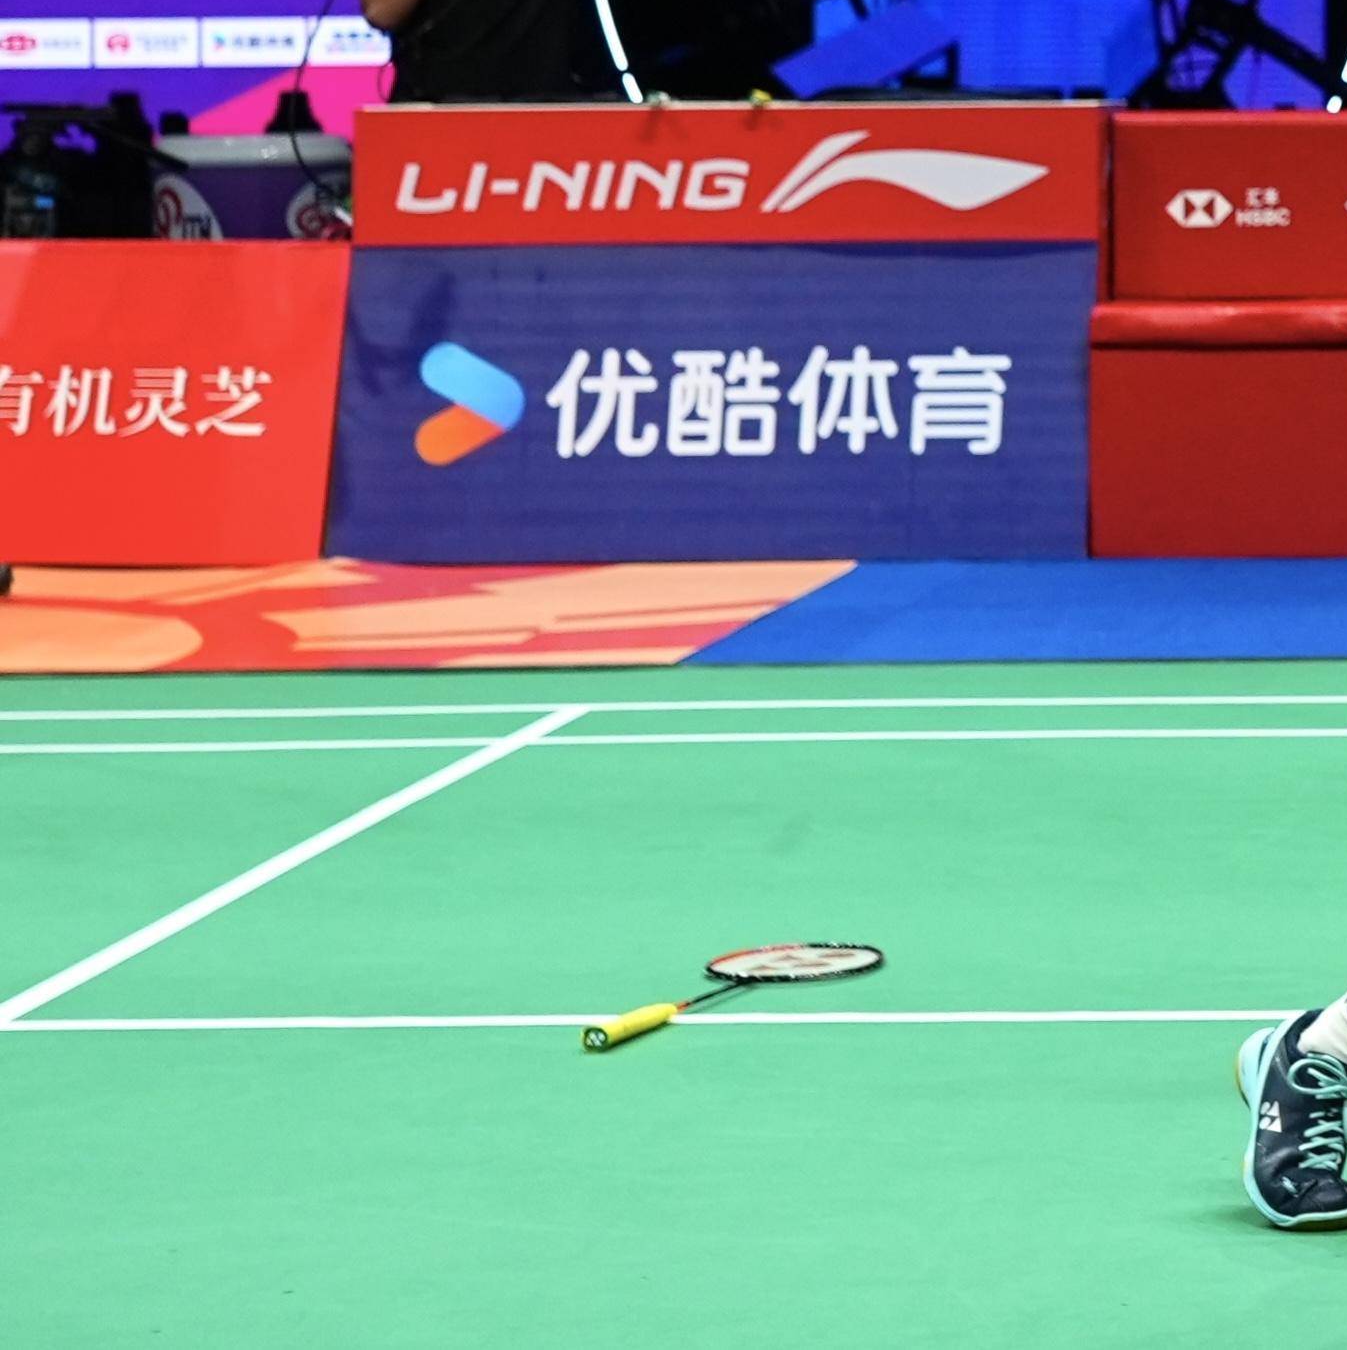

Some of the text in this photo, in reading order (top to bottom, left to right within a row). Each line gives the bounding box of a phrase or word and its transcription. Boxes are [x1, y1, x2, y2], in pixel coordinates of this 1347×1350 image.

[395, 160, 750, 214] LI-NING
[0, 364, 273, 438] 有机灵芝
[545, 345, 1013, 459] 优酷体育
